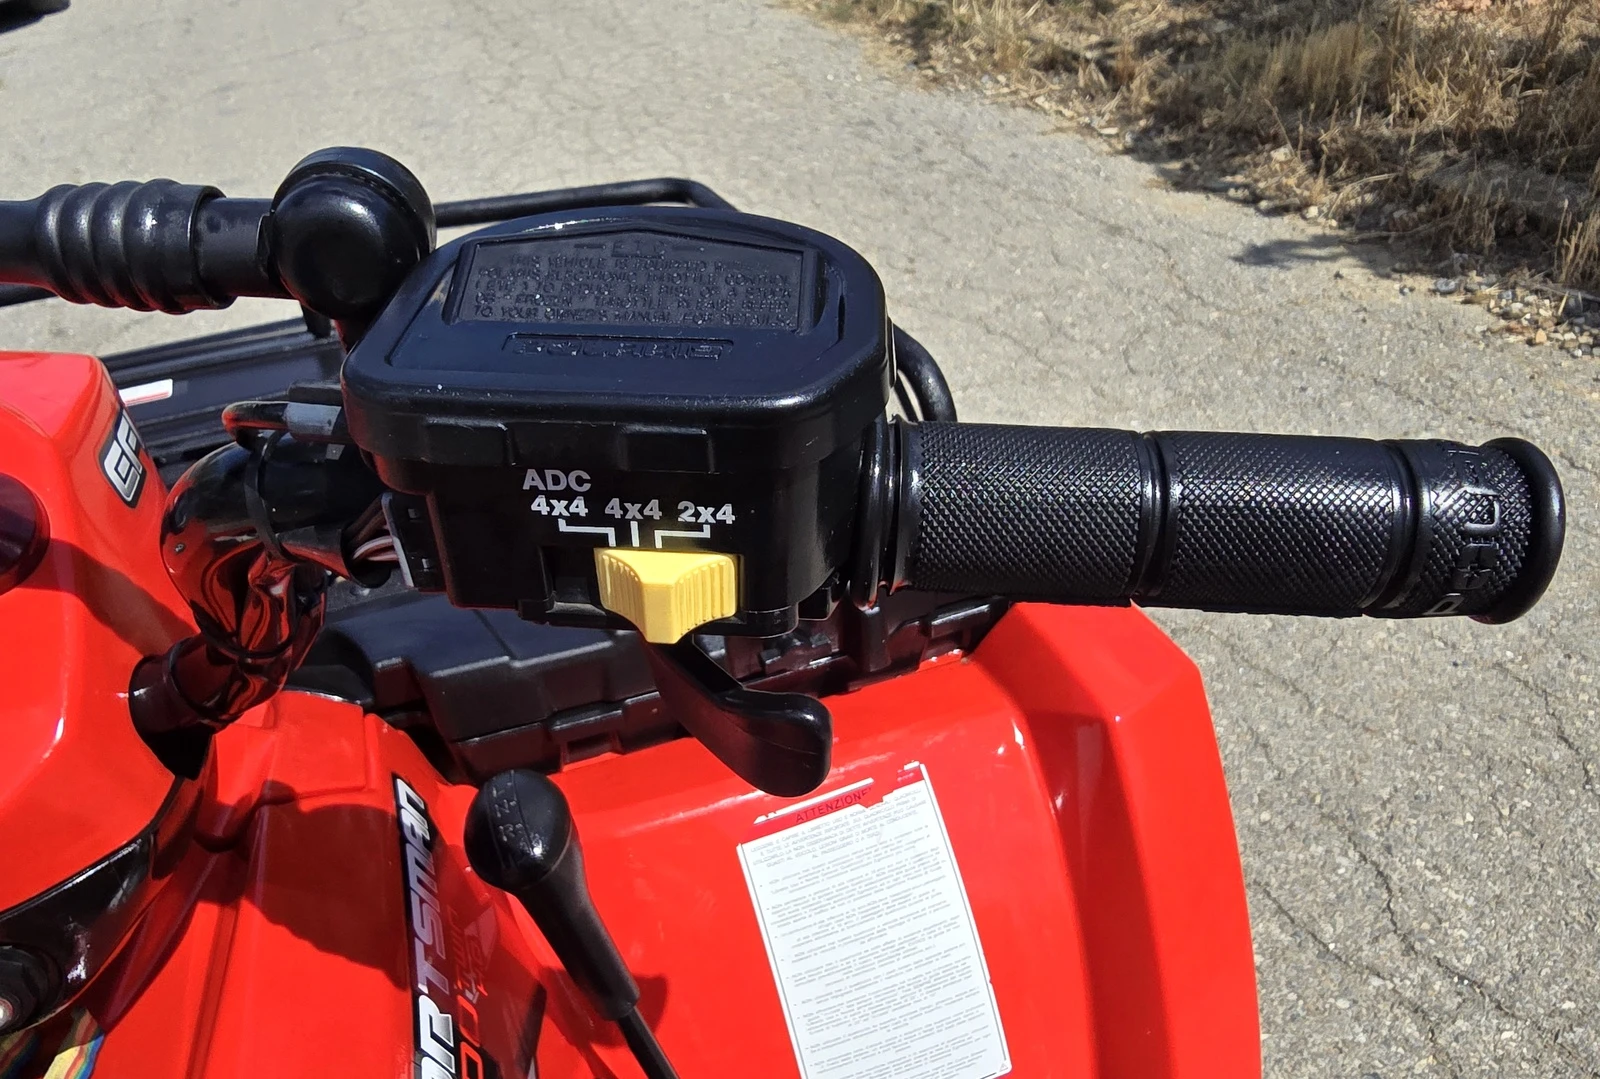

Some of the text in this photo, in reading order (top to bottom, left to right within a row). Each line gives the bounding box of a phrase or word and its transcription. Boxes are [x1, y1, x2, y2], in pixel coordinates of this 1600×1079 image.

[547, 255, 607, 269] VEHICLE
[614, 256, 628, 269] IS
[478, 266, 541, 281] POLARIS
[546, 268, 638, 283] ELECTRONIC
[475, 304, 493, 318] TO
[501, 306, 540, 320] YOUR
[522, 468, 592, 492] ADC
[530, 494, 736, 525] 4x4 4x4 2x4
